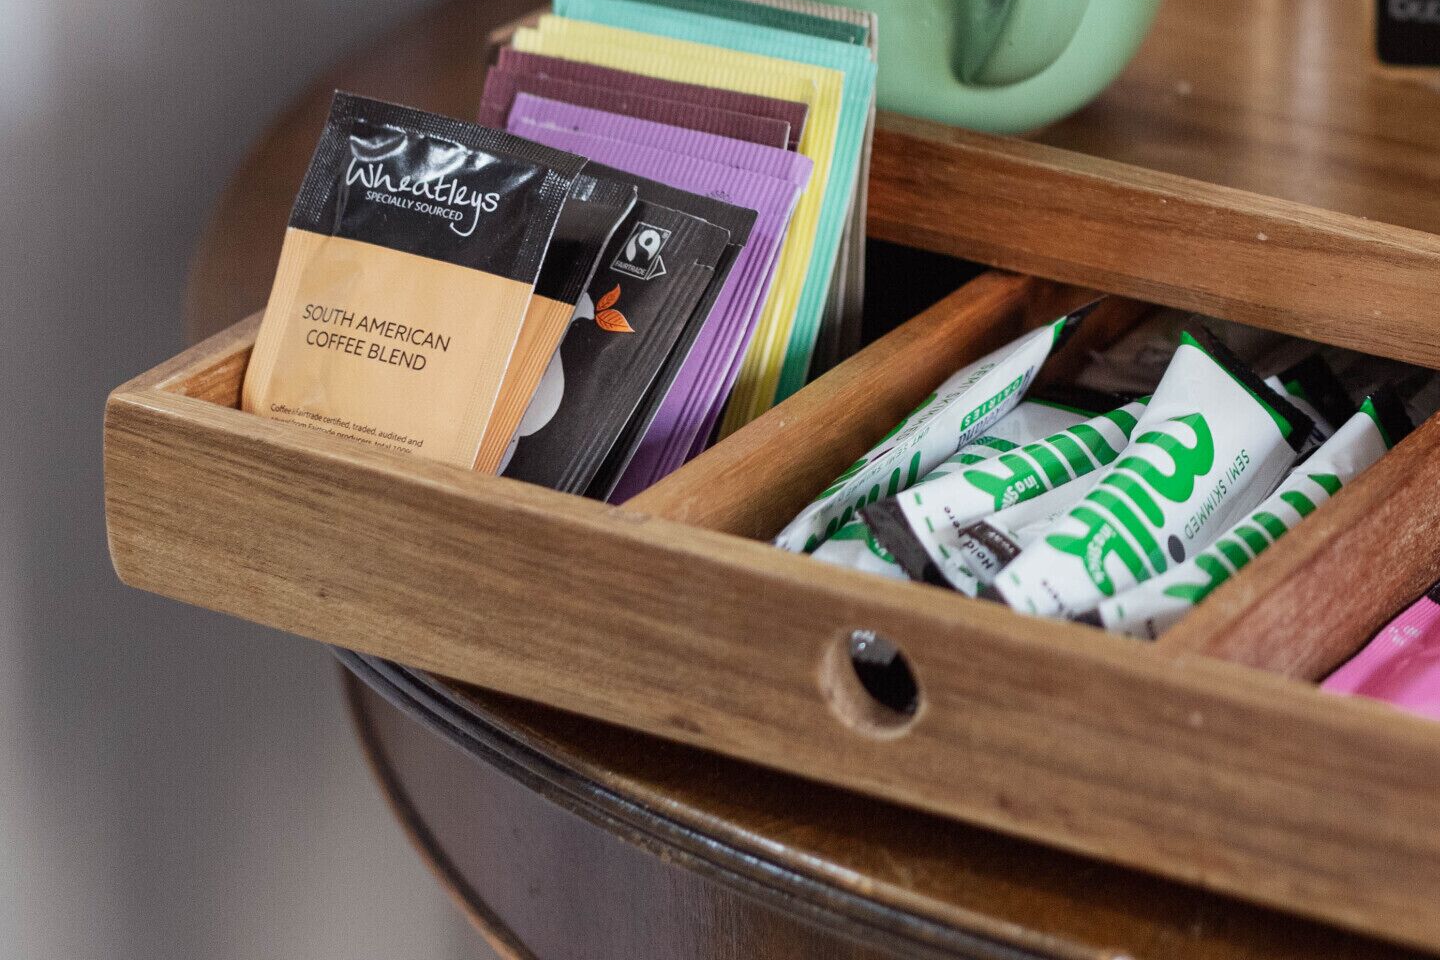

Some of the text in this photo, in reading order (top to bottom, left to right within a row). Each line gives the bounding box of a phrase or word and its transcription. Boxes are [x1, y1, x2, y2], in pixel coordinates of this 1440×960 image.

[345, 156, 500, 237] Wheatleys
[365, 190, 464, 222] SPECIALLY SOURCED
[613, 259, 647, 277] FAIRTRADE
[302, 303, 452, 353] SOUTH AMERICAN
[305, 328, 427, 372] COFFEE BLEND
[378, 431, 407, 444] audited
[407, 438, 424, 449] and
[1183, 448, 1251, 541] SEMI SKIMMED
